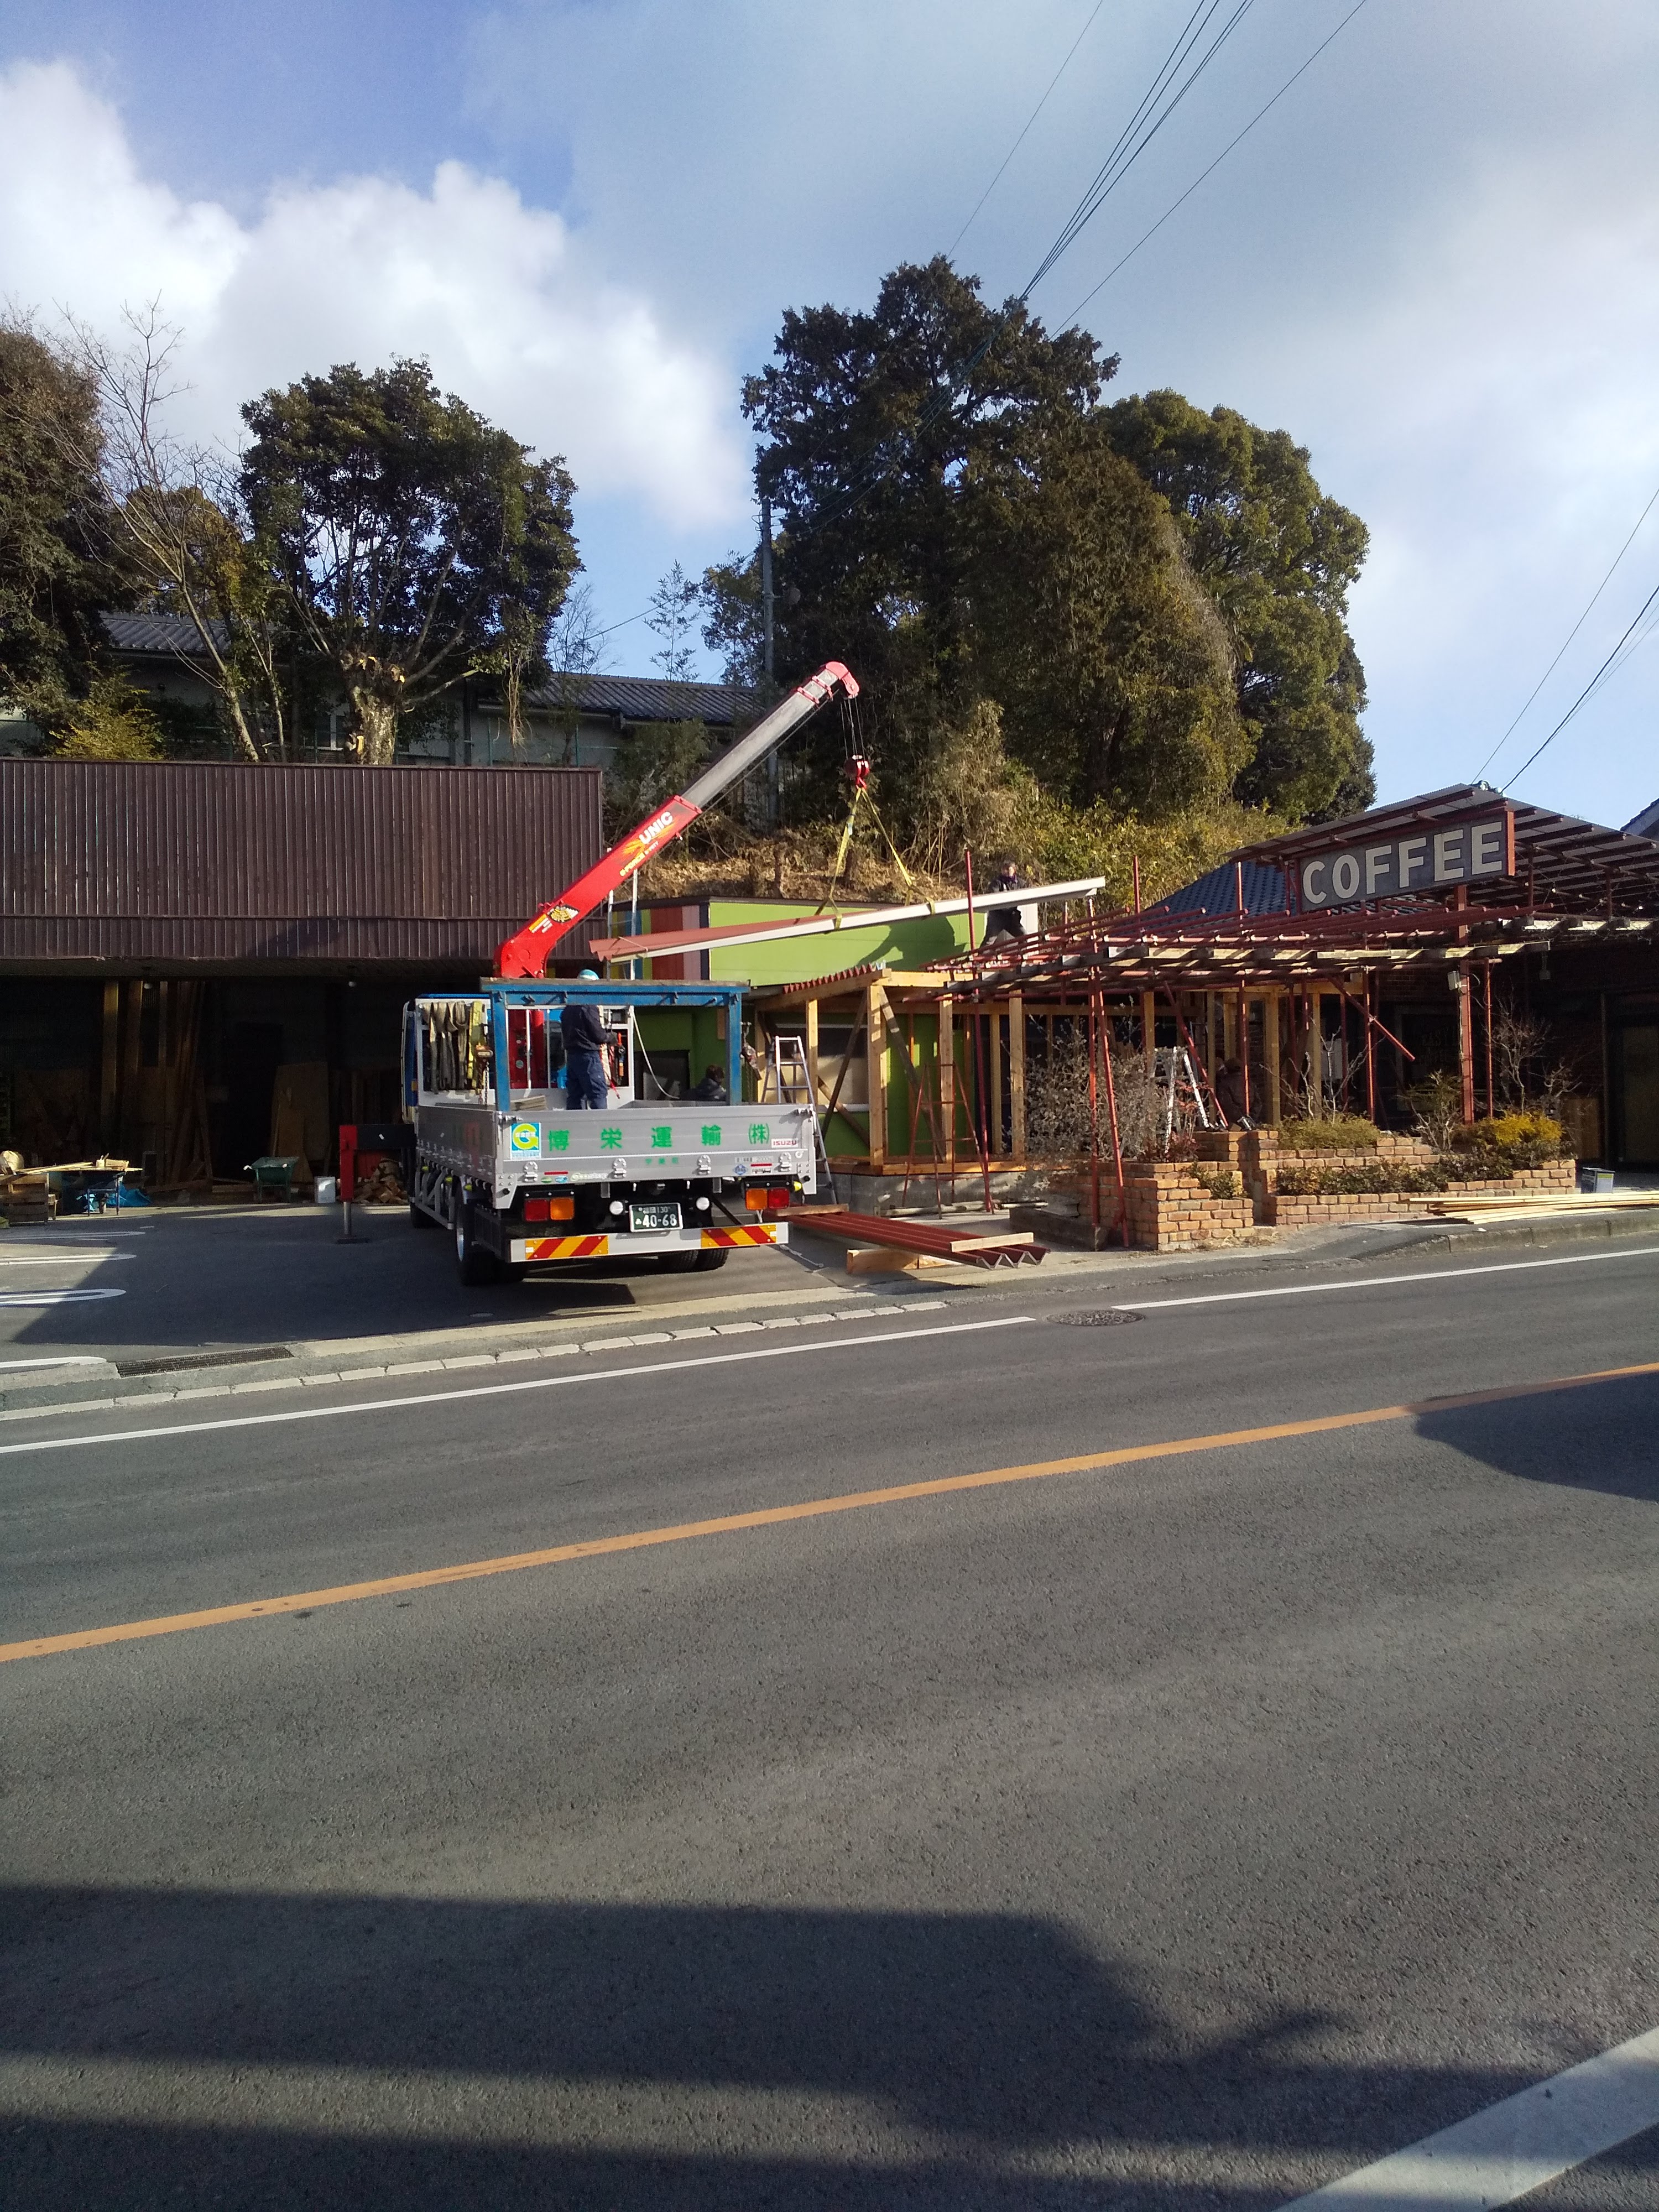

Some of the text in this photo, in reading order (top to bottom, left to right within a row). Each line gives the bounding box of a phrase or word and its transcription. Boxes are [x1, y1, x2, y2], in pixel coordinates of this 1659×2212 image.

[639, 811, 673, 844] UNIC
[1302, 822, 1503, 904] COFFEE
[643, 1214, 677, 1228] 40-68
